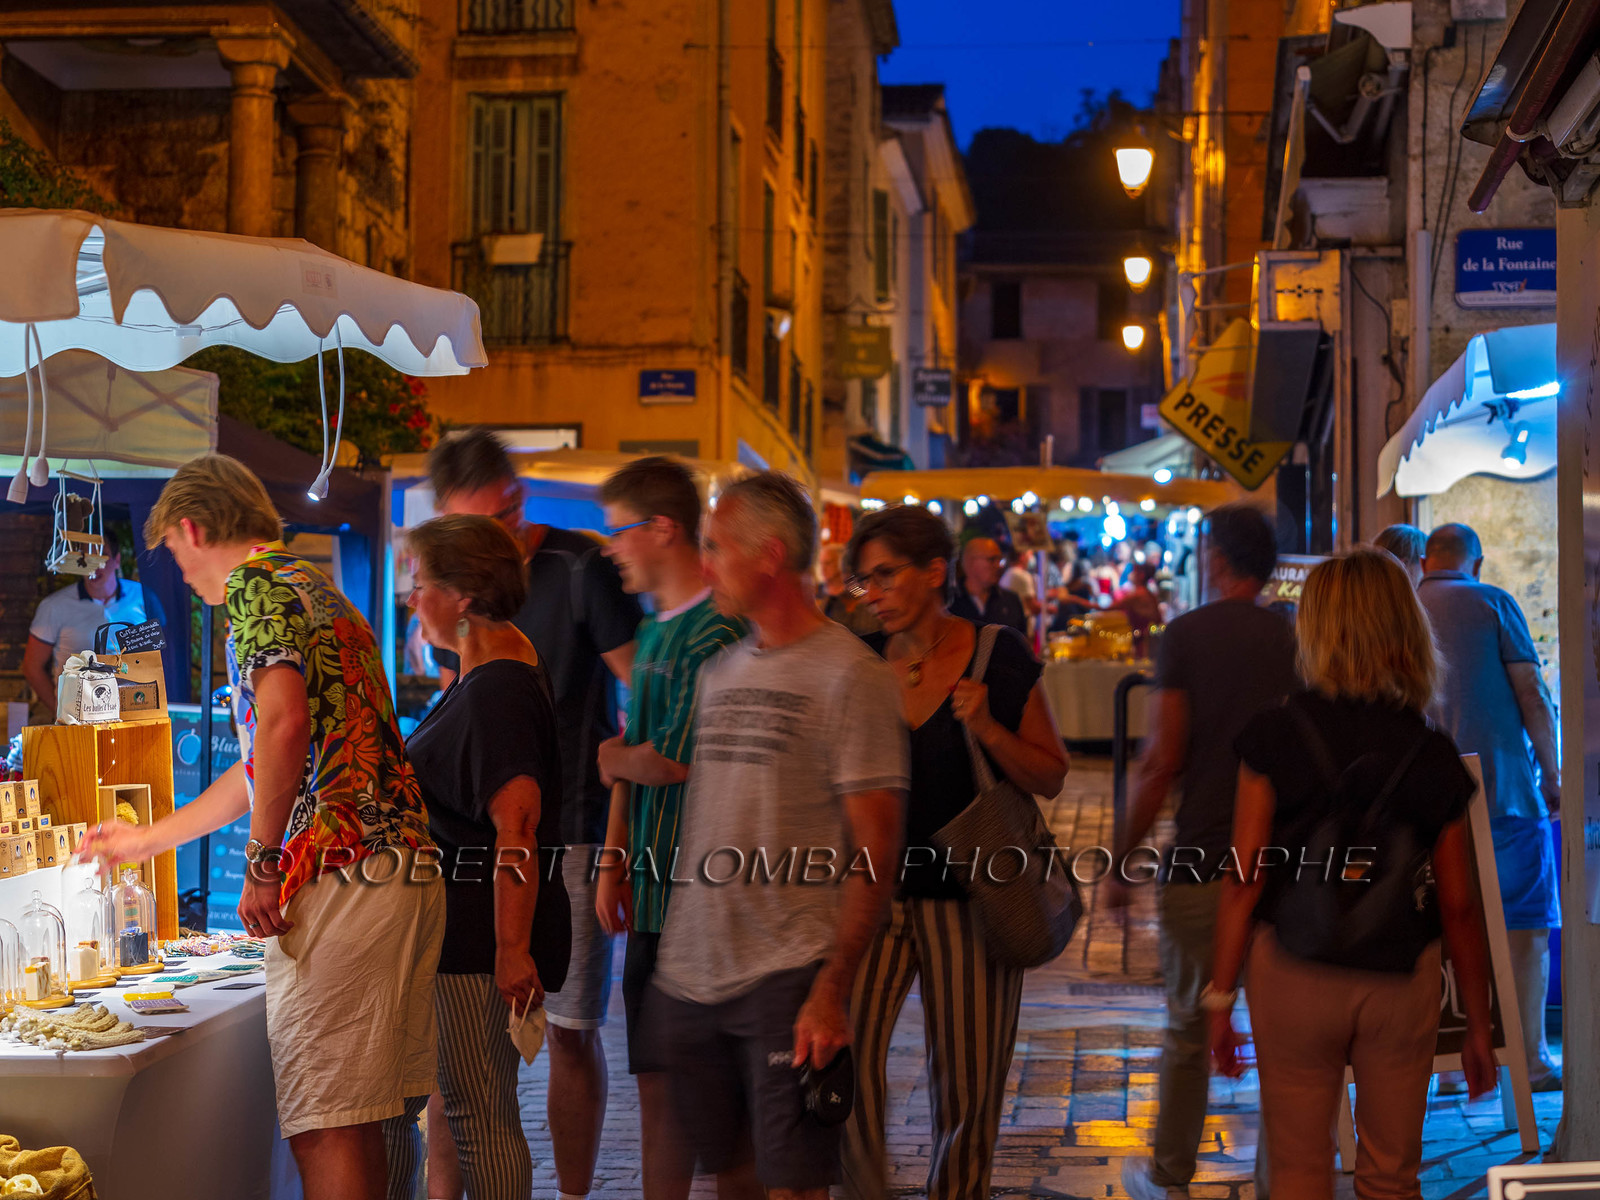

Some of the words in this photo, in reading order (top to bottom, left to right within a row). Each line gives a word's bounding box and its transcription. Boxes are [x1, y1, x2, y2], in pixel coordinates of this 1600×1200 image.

[1496, 236, 1524, 250] Rue
[1462, 257, 1479, 272] de
[1482, 257, 1495, 272] la
[1498, 257, 1557, 271] Fontaine
[1172, 391, 1264, 475] PRESSE
